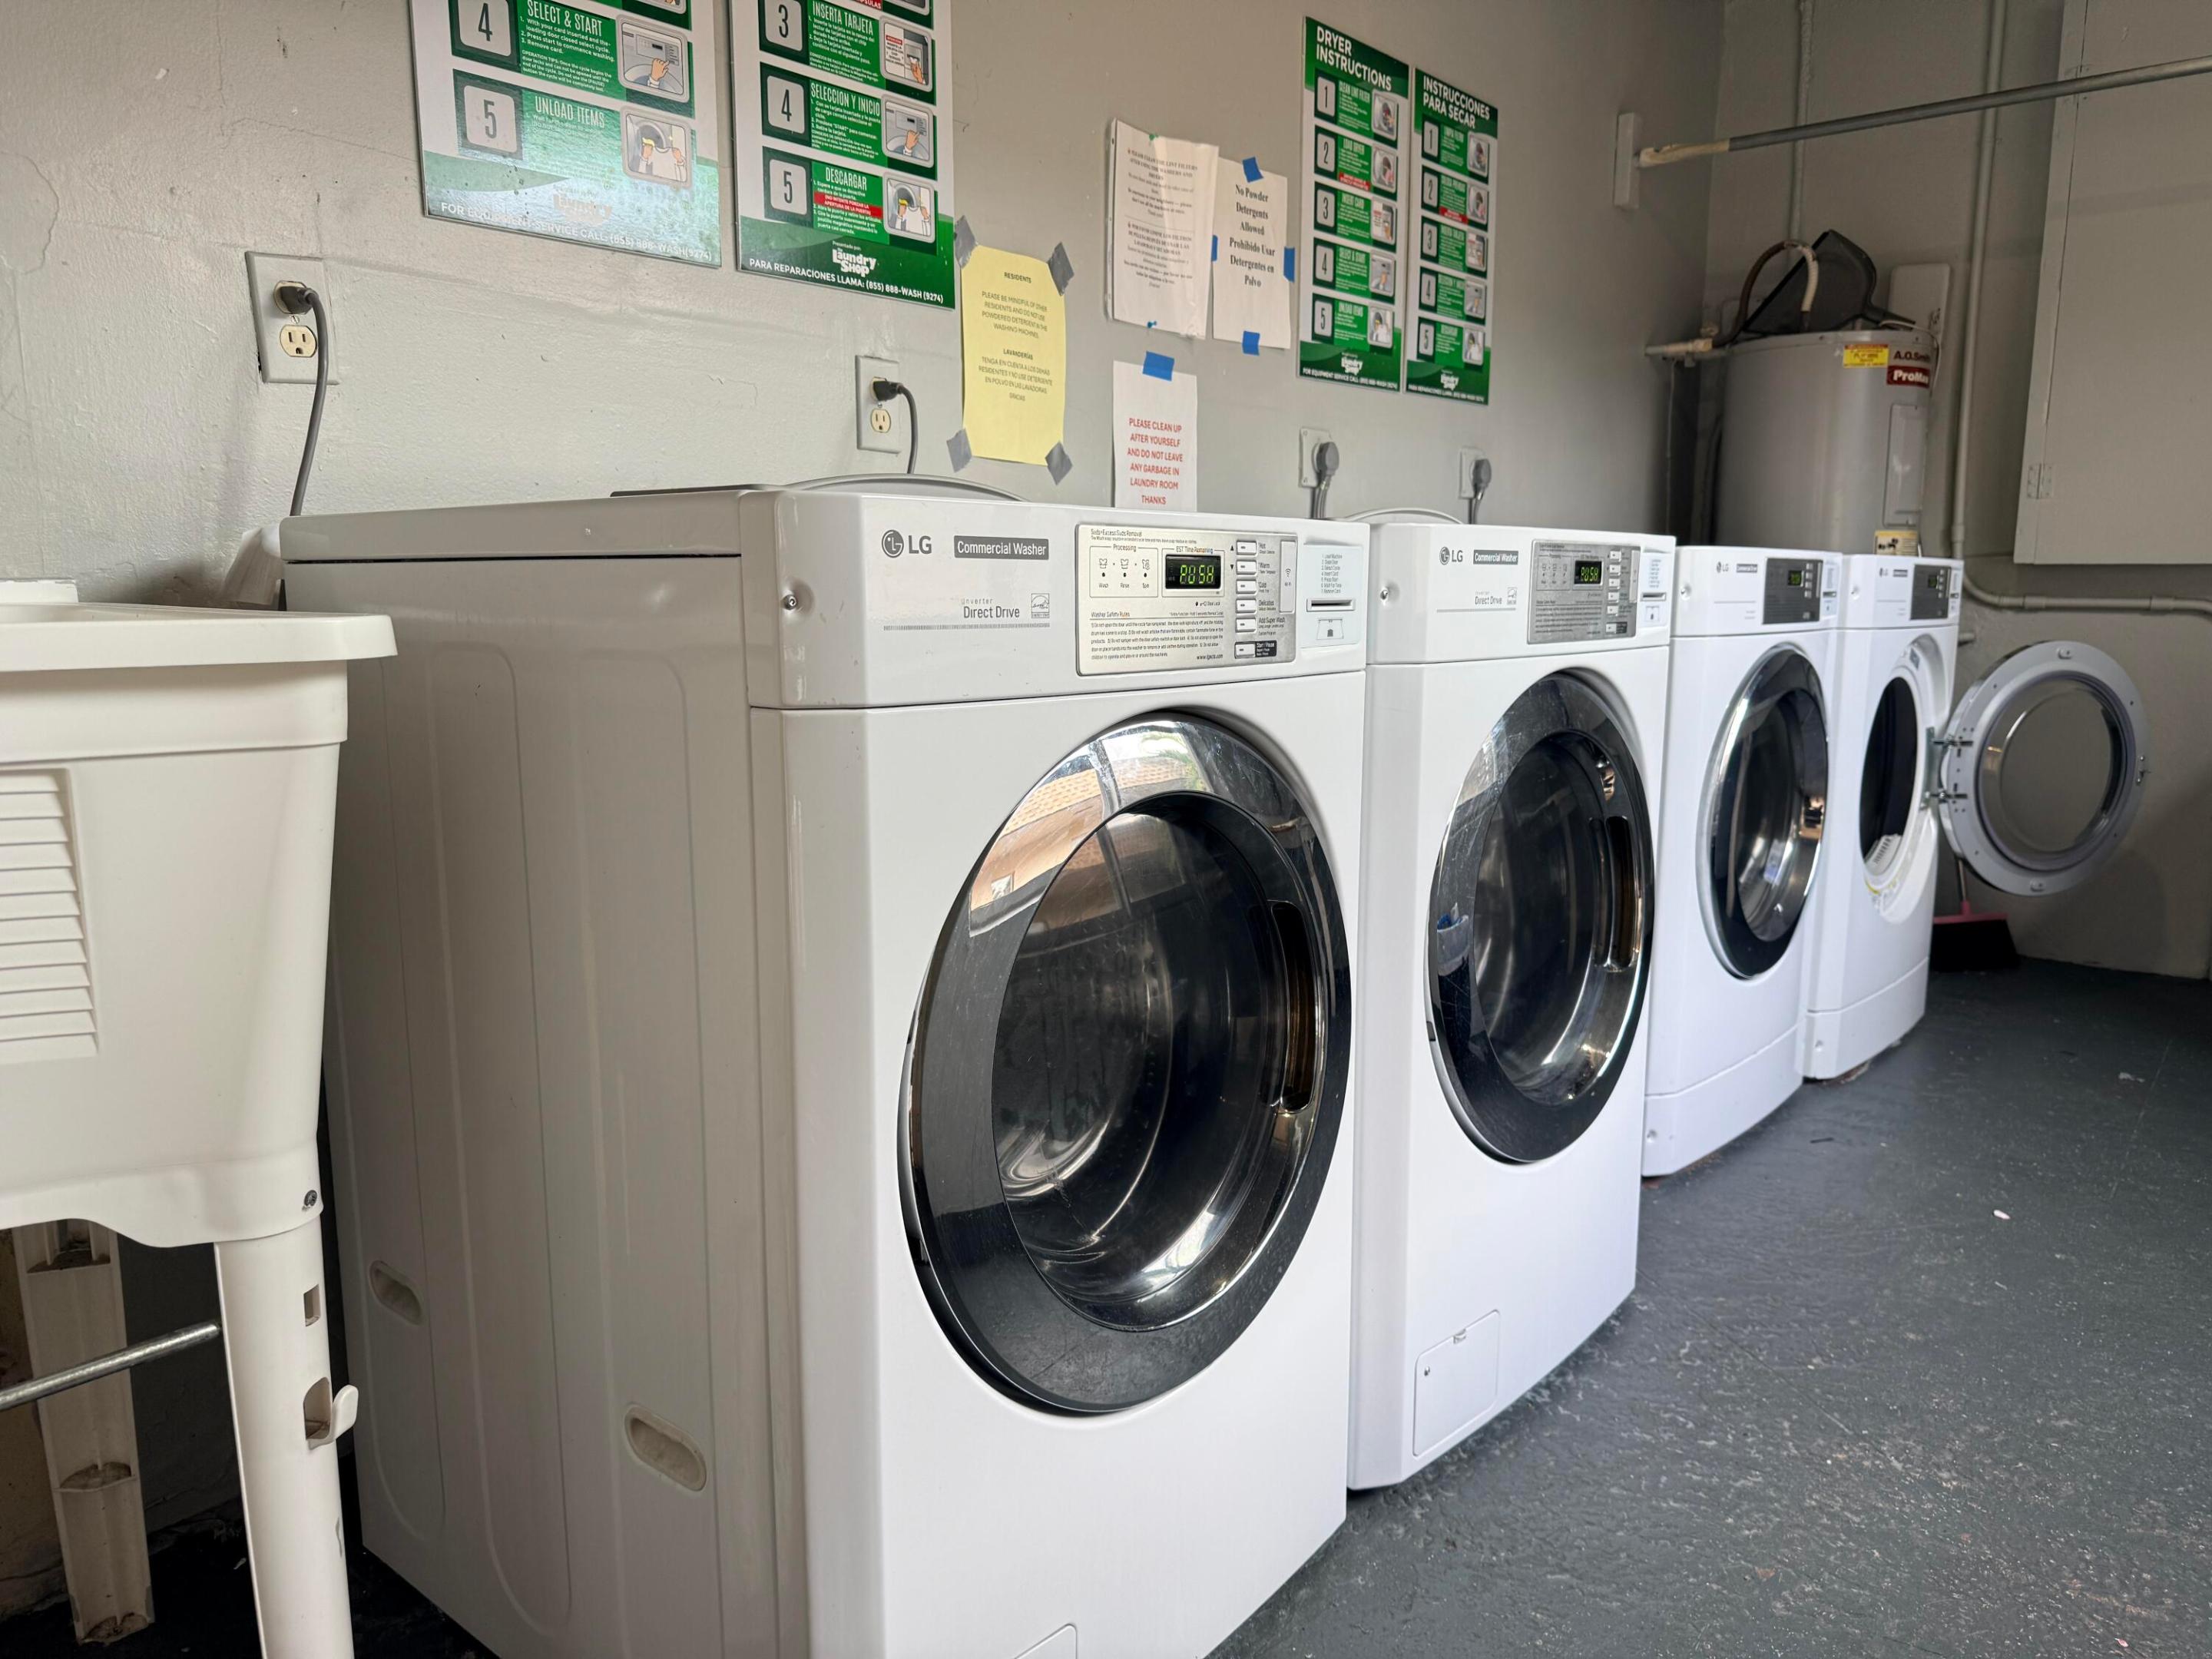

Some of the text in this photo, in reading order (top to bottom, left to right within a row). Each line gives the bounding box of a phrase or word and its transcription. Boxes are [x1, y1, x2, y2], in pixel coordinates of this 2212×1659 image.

[478, 3, 492, 41] 4
[528, 0, 602, 37] SELECT & START
[779, 4, 789, 38] 3
[813, 1, 873, 36] INSERTA TARJETA
[526, 25, 546, 36] loading
[561, 35, 578, 44] closed
[579, 41, 594, 49] select
[528, 40, 549, 50] Remove
[567, 29, 588, 41] inserted
[1316, 25, 1352, 57] DRYER
[527, 32, 541, 41] Press
[542, 37, 558, 45] start
[564, 44, 591, 55] commence
[593, 51, 614, 62] washing.
[1316, 44, 1392, 92] INSTRUCTIONS
[781, 89, 792, 122] 4
[811, 83, 880, 117] SELECCION Y INICIO
[1324, 85, 1328, 109] 1
[1423, 75, 1490, 121] INSTRUCCIONES
[483, 99, 497, 139] 5
[535, 96, 573, 121] UNLOAD
[578, 107, 604, 128] ITEMS
[1423, 93, 1475, 129] PARA SECAR
[1429, 129, 1433, 150] 1
[1323, 141, 1329, 164] 2
[784, 171, 793, 204] 5
[826, 167, 867, 191] DESCARGAR
[1235, 184, 1269, 203] No Powder
[1429, 180, 1433, 200] 2
[442, 202, 465, 216] FOR
[1236, 201, 1269, 220] Detergents
[1323, 196, 1329, 220] 3
[1240, 221, 1264, 237] Allowed
[1230, 237, 1275, 257] Prohibido Usar
[1427, 229, 1432, 250] 3
[833, 249, 877, 270] Laundry
[1230, 255, 1266, 273] Detergentes
[1322, 253, 1327, 276] 4
[750, 259, 943, 303] PARA REPARACIONES LLAMA: (855) 888-WASH (9274)
[1005, 272, 1031, 283] RESIDENTS
[1244, 275, 1262, 288] Polvo
[982, 291, 1000, 300] PLEASE
[1008, 296, 1029, 306] MINDFUL
[1426, 280, 1432, 300] 4
[982, 310, 1012, 323] POWDERED
[985, 301, 1012, 312] RESIDENTS
[994, 323, 1018, 333] WASHING
[1321, 308, 1326, 330] 5
[1424, 329, 1429, 349] 5
[979, 366, 1008, 376] RESIDENTES
[982, 356, 998, 366] TENGA
[1311, 369, 1334, 379] EQUIPMENT
[1129, 417, 1182, 433] PLEASE CLEAN UP
[1130, 433, 1181, 448] AFTER YOURSELF
[1128, 448, 1183, 462] AND DO NOT LEAVE
[1131, 463, 1180, 476] ANY GARBAGE IN
[1131, 478, 1179, 490] LAUNDRY ROOM
[1141, 495, 1167, 505] THANKS
[909, 535, 932, 555] LG
[957, 541, 1046, 556] Commercial Washer
[1113, 544, 1137, 552] Processing
[1452, 550, 1463, 563] LG
[1475, 552, 1518, 563] Commercial Washer
[1475, 596, 1502, 605] Direct Drive
[963, 606, 1020, 619] Direct Drive
